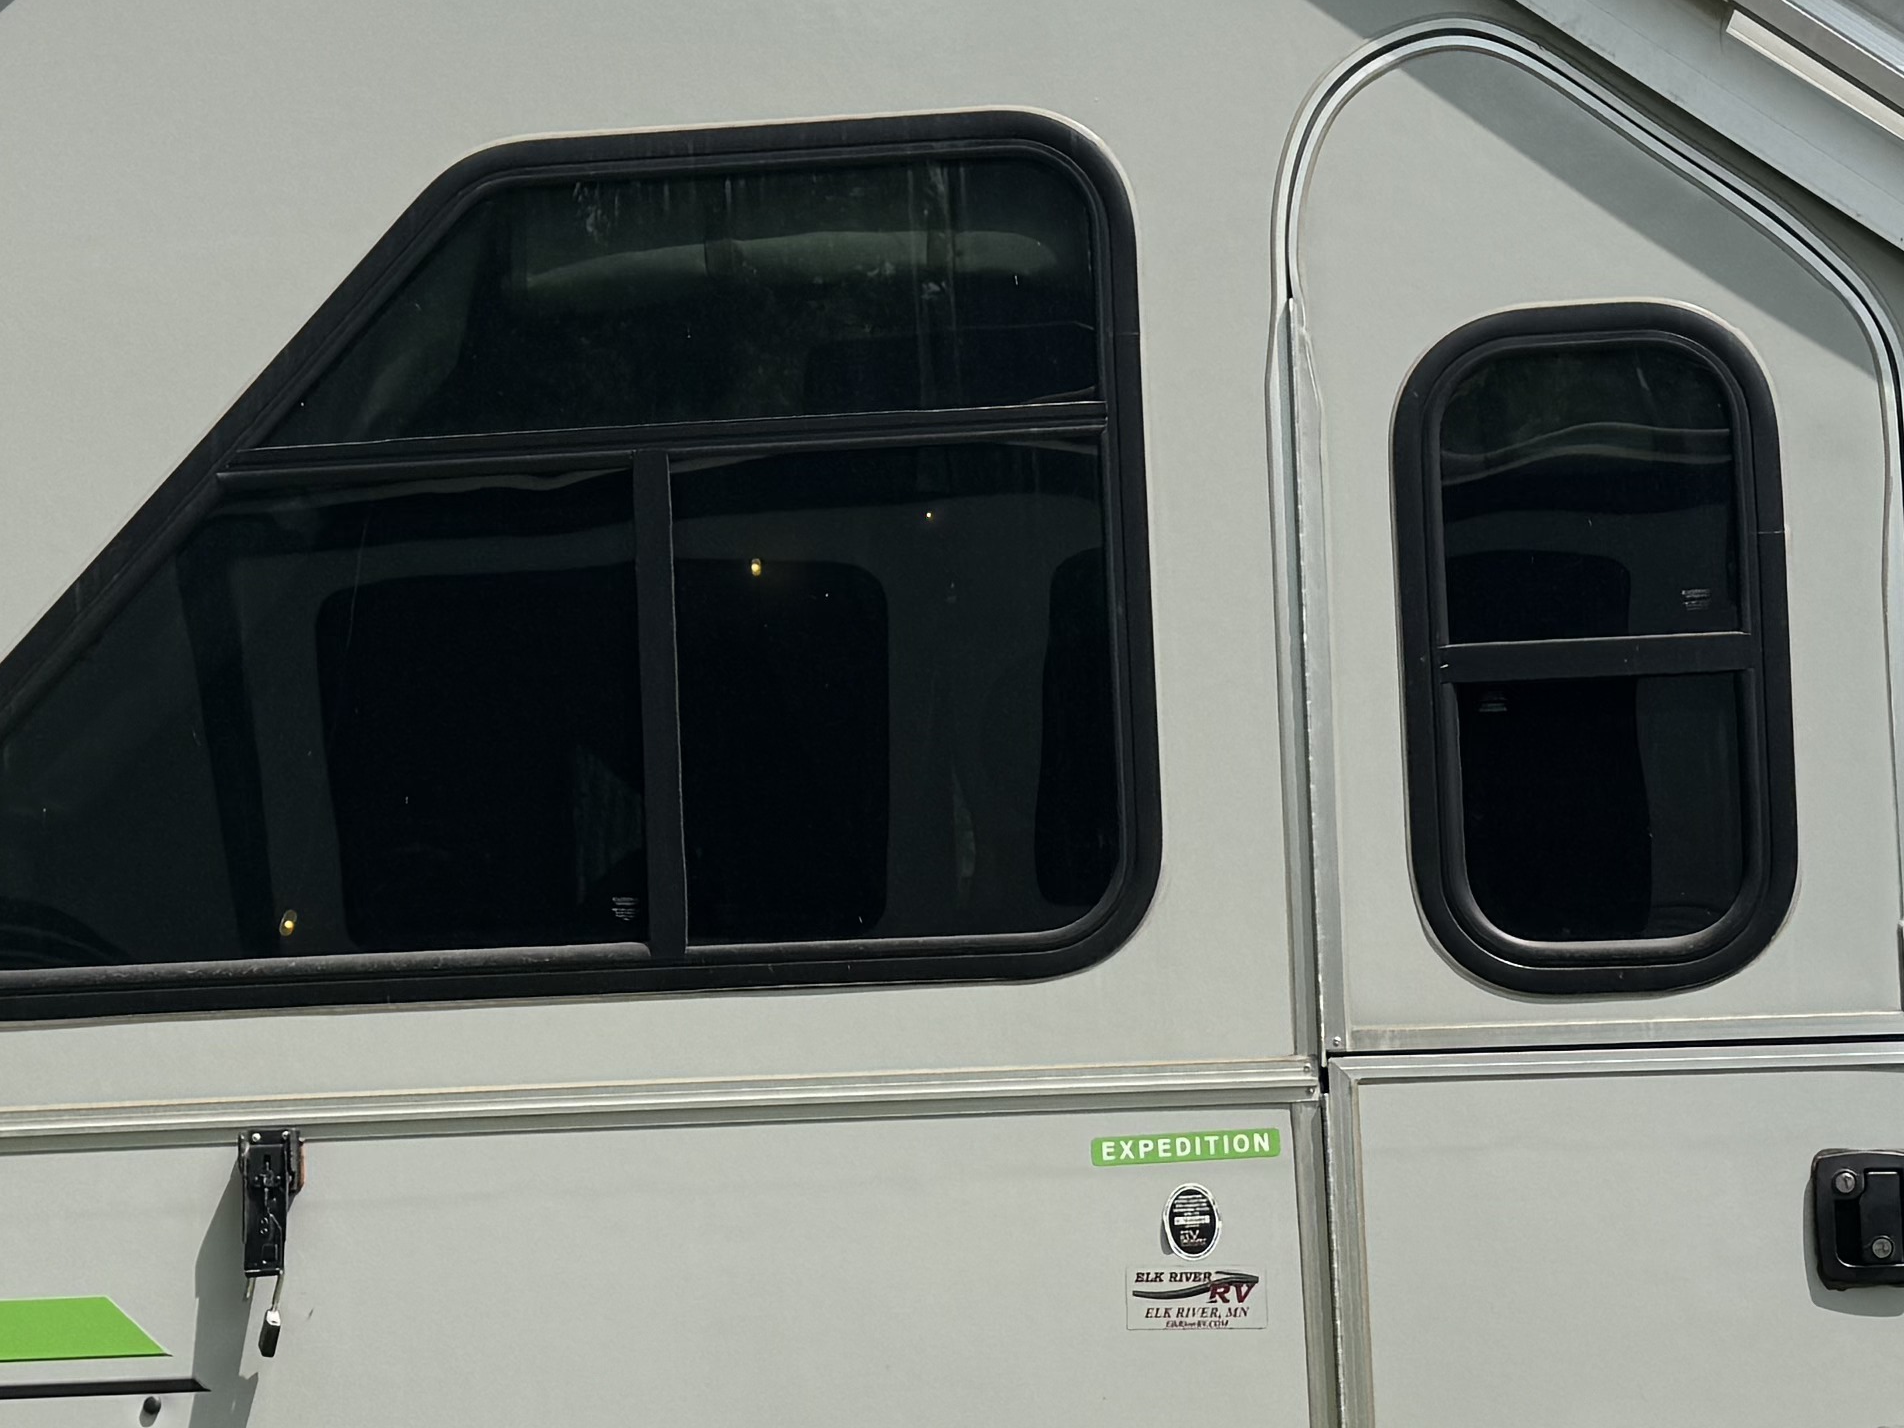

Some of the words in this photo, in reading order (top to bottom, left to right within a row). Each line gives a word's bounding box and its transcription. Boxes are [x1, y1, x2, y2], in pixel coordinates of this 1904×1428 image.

[1101, 1132, 1271, 1161] EXPEDITION
[1135, 1272, 1165, 1283] ELK
[1168, 1272, 1213, 1283] RIVER
[1208, 1282, 1257, 1304] RV
[1144, 1307, 1173, 1318] ELK
[1175, 1307, 1222, 1319] RIVER,
[1225, 1306, 1250, 1318] MN
